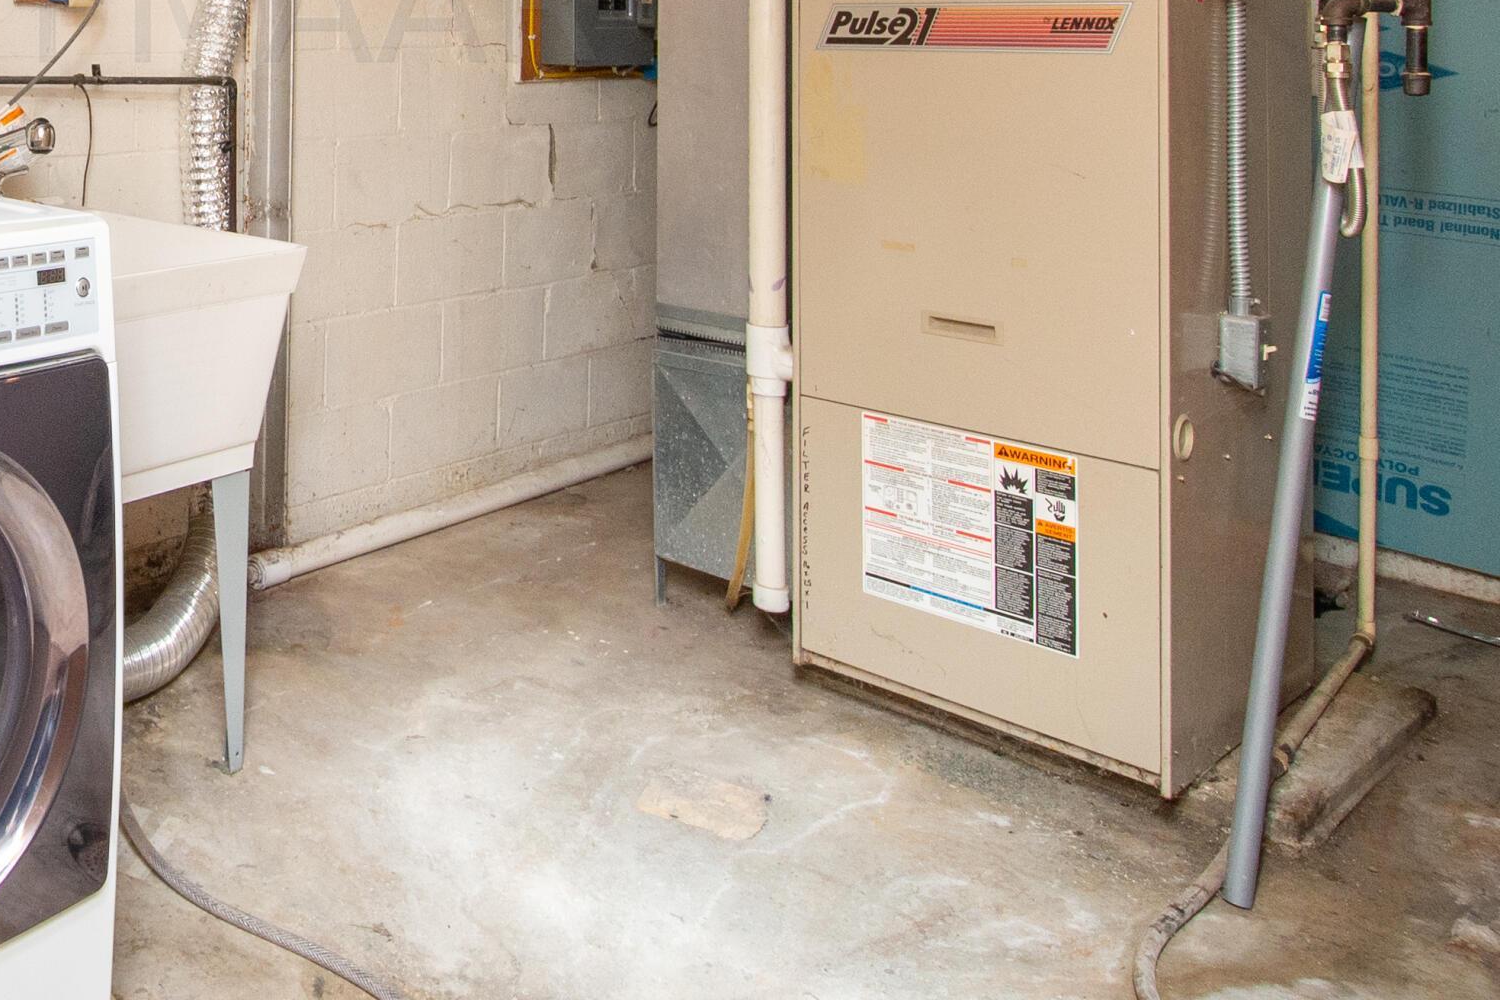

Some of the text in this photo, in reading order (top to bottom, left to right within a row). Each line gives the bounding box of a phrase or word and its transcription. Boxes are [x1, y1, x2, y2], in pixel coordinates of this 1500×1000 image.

[1051, 16, 1119, 31] LENNOX
[1429, 200, 1500, 220] Stabilized
[1393, 216, 1436, 232] Board
[1440, 222, 1500, 241] Nominal
